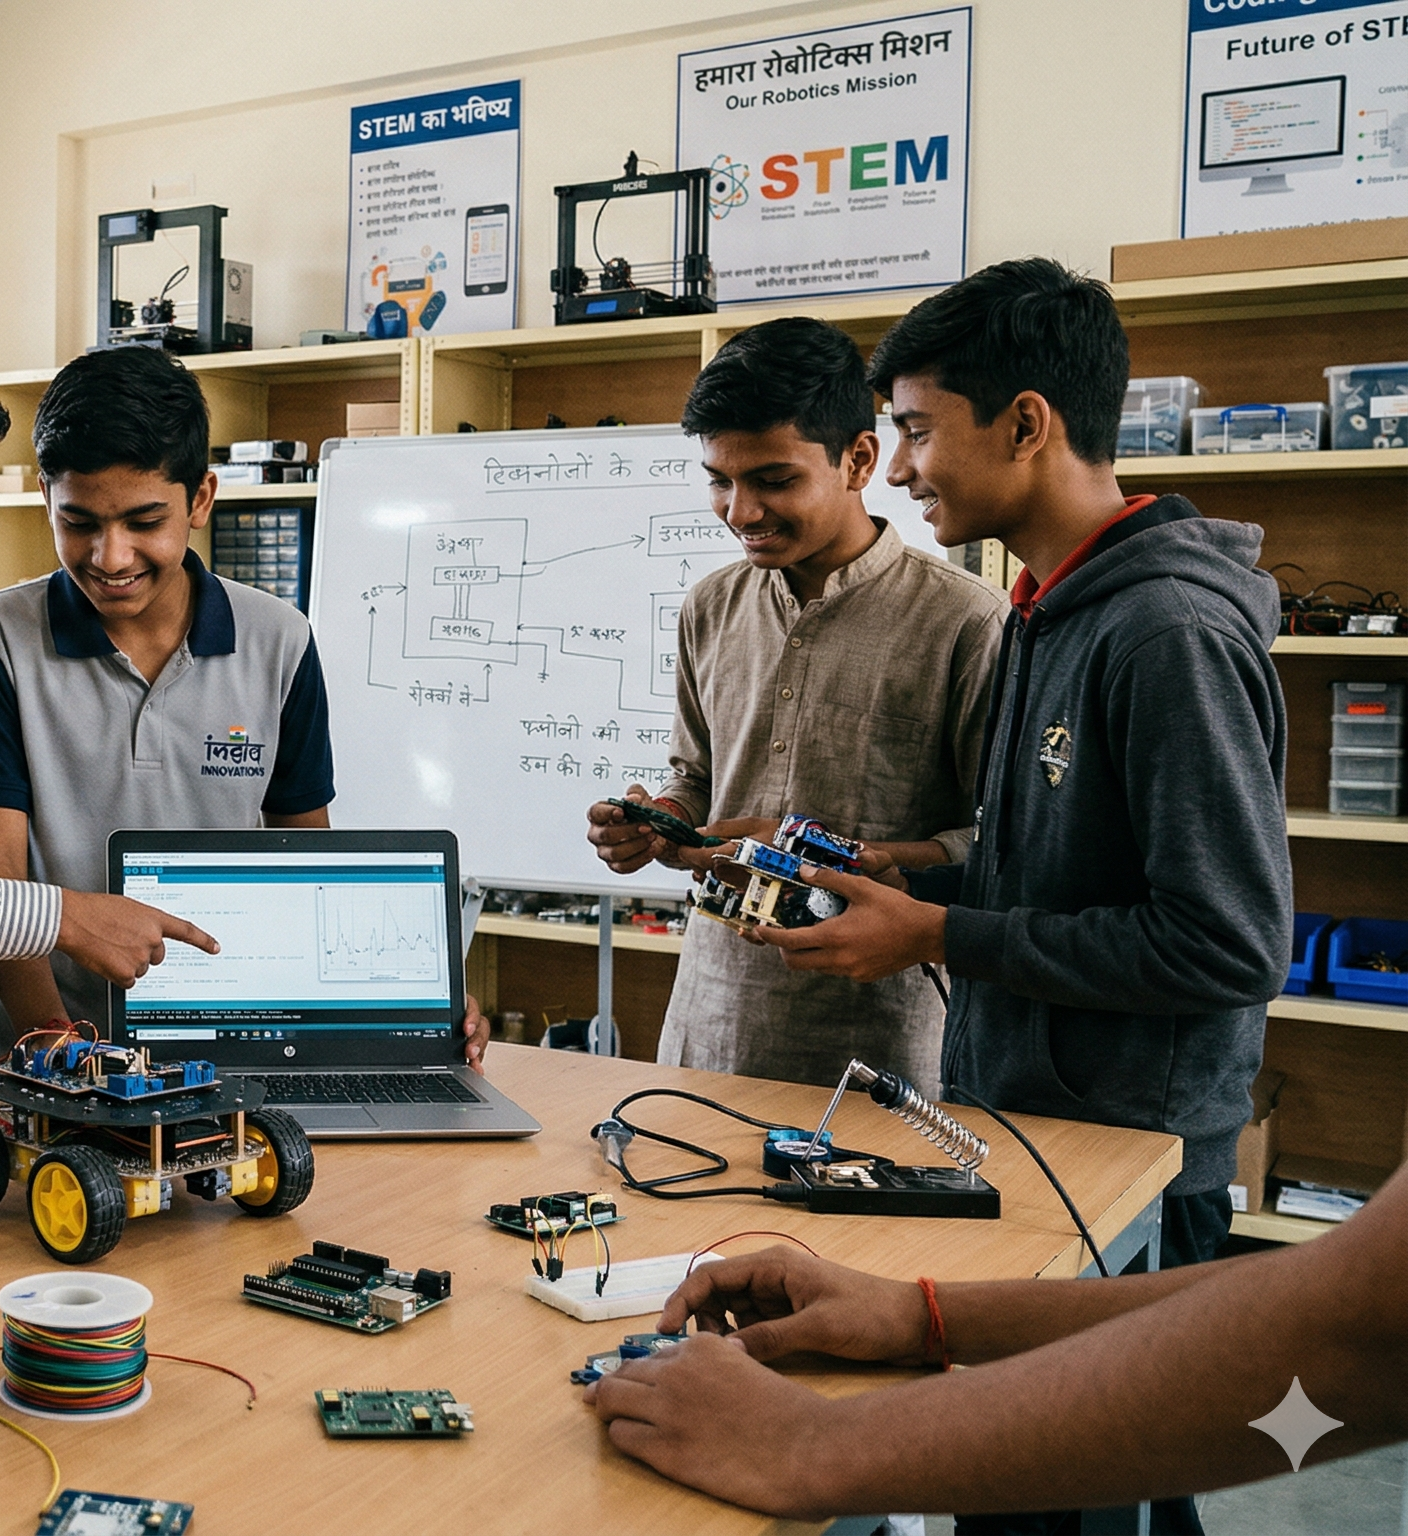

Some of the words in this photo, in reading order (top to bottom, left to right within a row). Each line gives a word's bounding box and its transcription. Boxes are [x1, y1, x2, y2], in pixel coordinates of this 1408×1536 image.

[694, 61, 756, 92] हमारा
[763, 42, 873, 79] रोबोटिक्स
[881, 30, 952, 62] मिशन
[1227, 33, 1315, 60] Future
[1325, 22, 1354, 46] of
[725, 94, 763, 110] Our
[762, 81, 840, 105] Robotics
[846, 70, 918, 93] Mission
[359, 113, 415, 140] STEM
[420, 108, 448, 130] का
[451, 95, 513, 125] भविष्य
[760, 135, 949, 200] STEM
